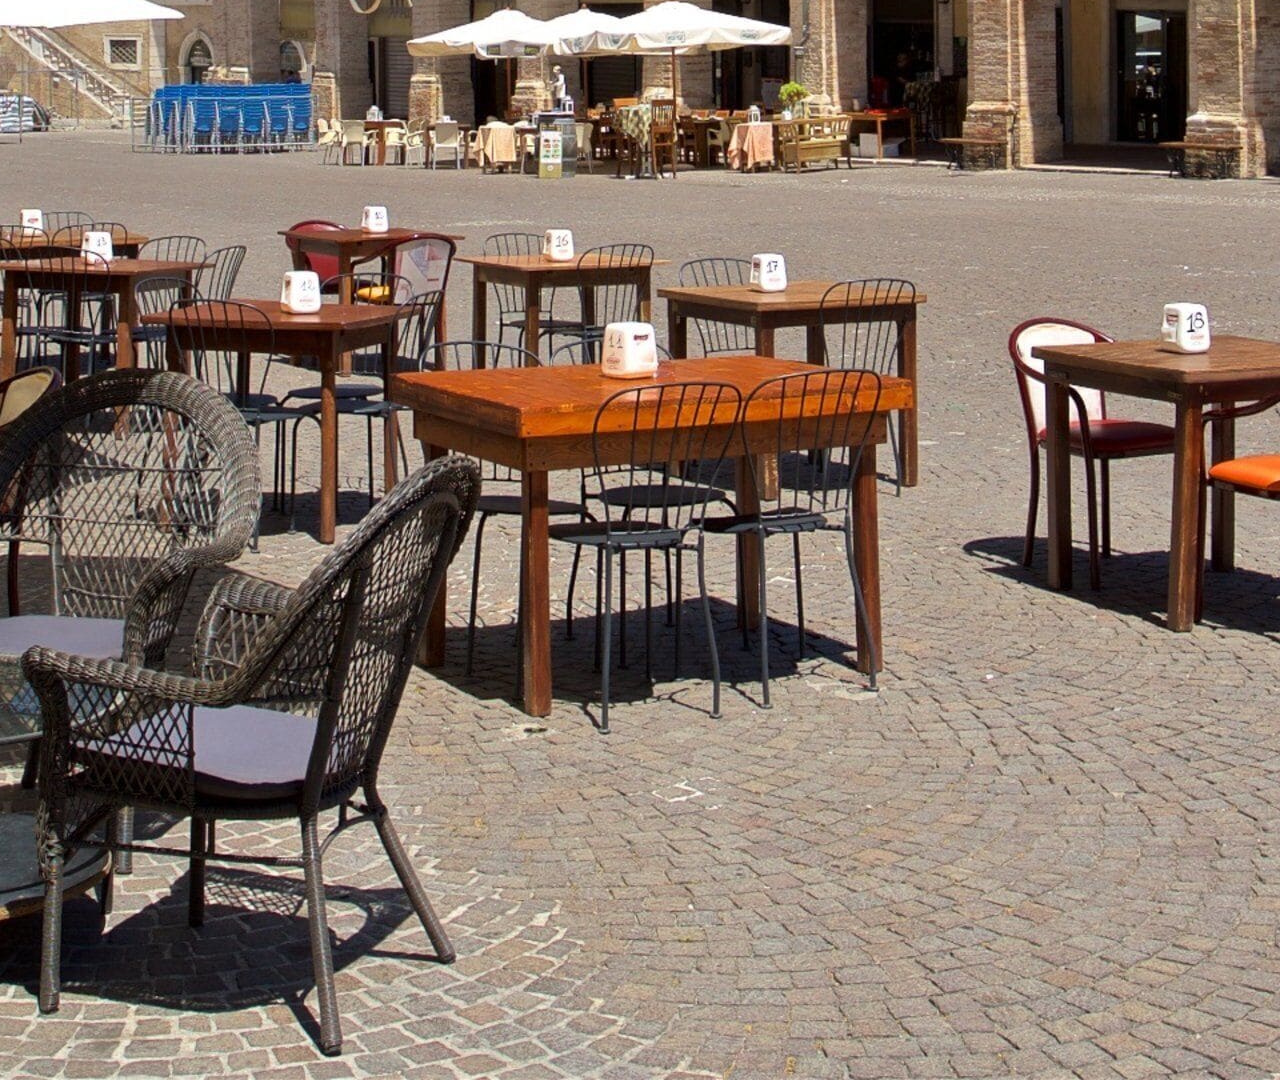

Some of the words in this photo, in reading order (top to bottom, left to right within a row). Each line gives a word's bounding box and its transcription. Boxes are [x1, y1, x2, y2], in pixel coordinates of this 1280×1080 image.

[555, 234, 569, 247] 16
[766, 260, 778, 274] 17
[1186, 311, 1205, 333] 18
